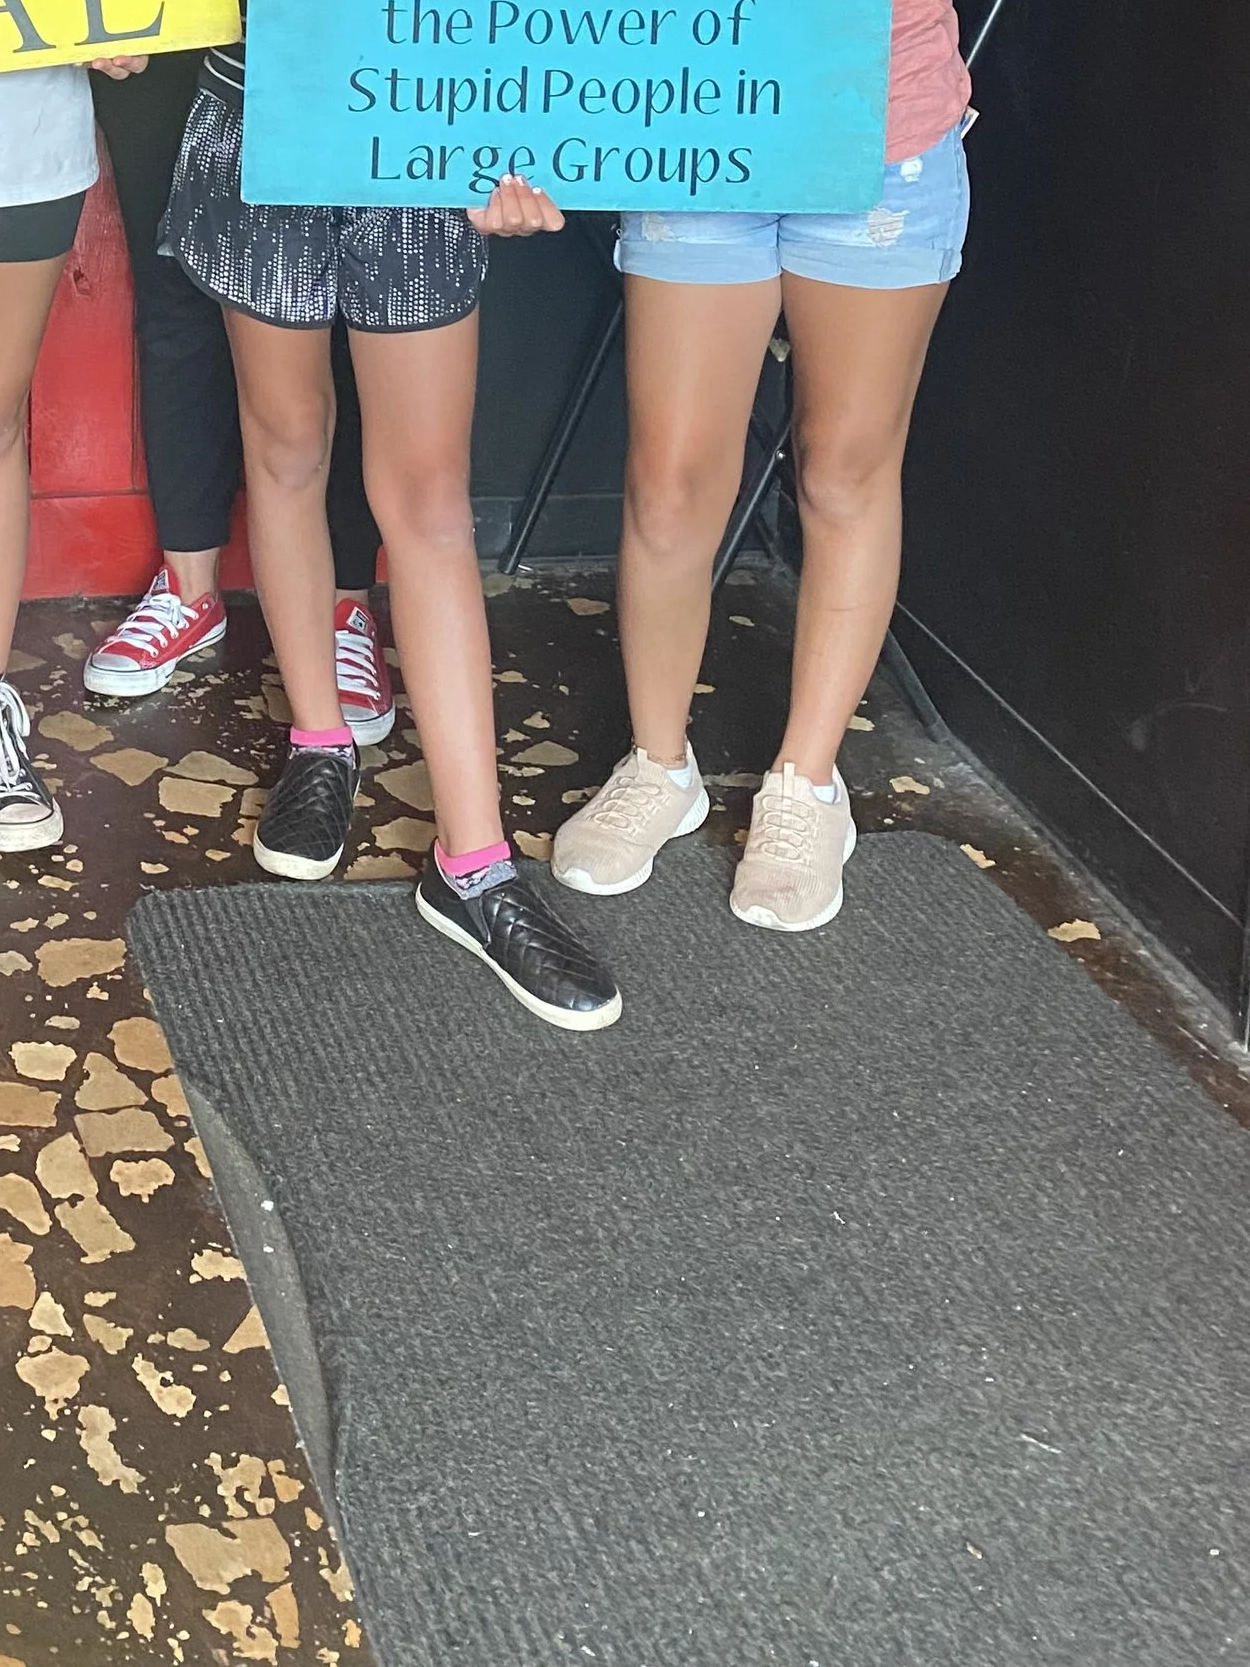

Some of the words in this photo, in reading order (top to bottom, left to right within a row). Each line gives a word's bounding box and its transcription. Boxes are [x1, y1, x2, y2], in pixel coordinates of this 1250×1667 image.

[488, 0, 677, 46] Power
[347, 66, 528, 126] Stupid
[543, 68, 721, 127] People
[736, 69, 782, 115] in
[370, 136, 536, 194] Large
[552, 137, 753, 197] Groups
